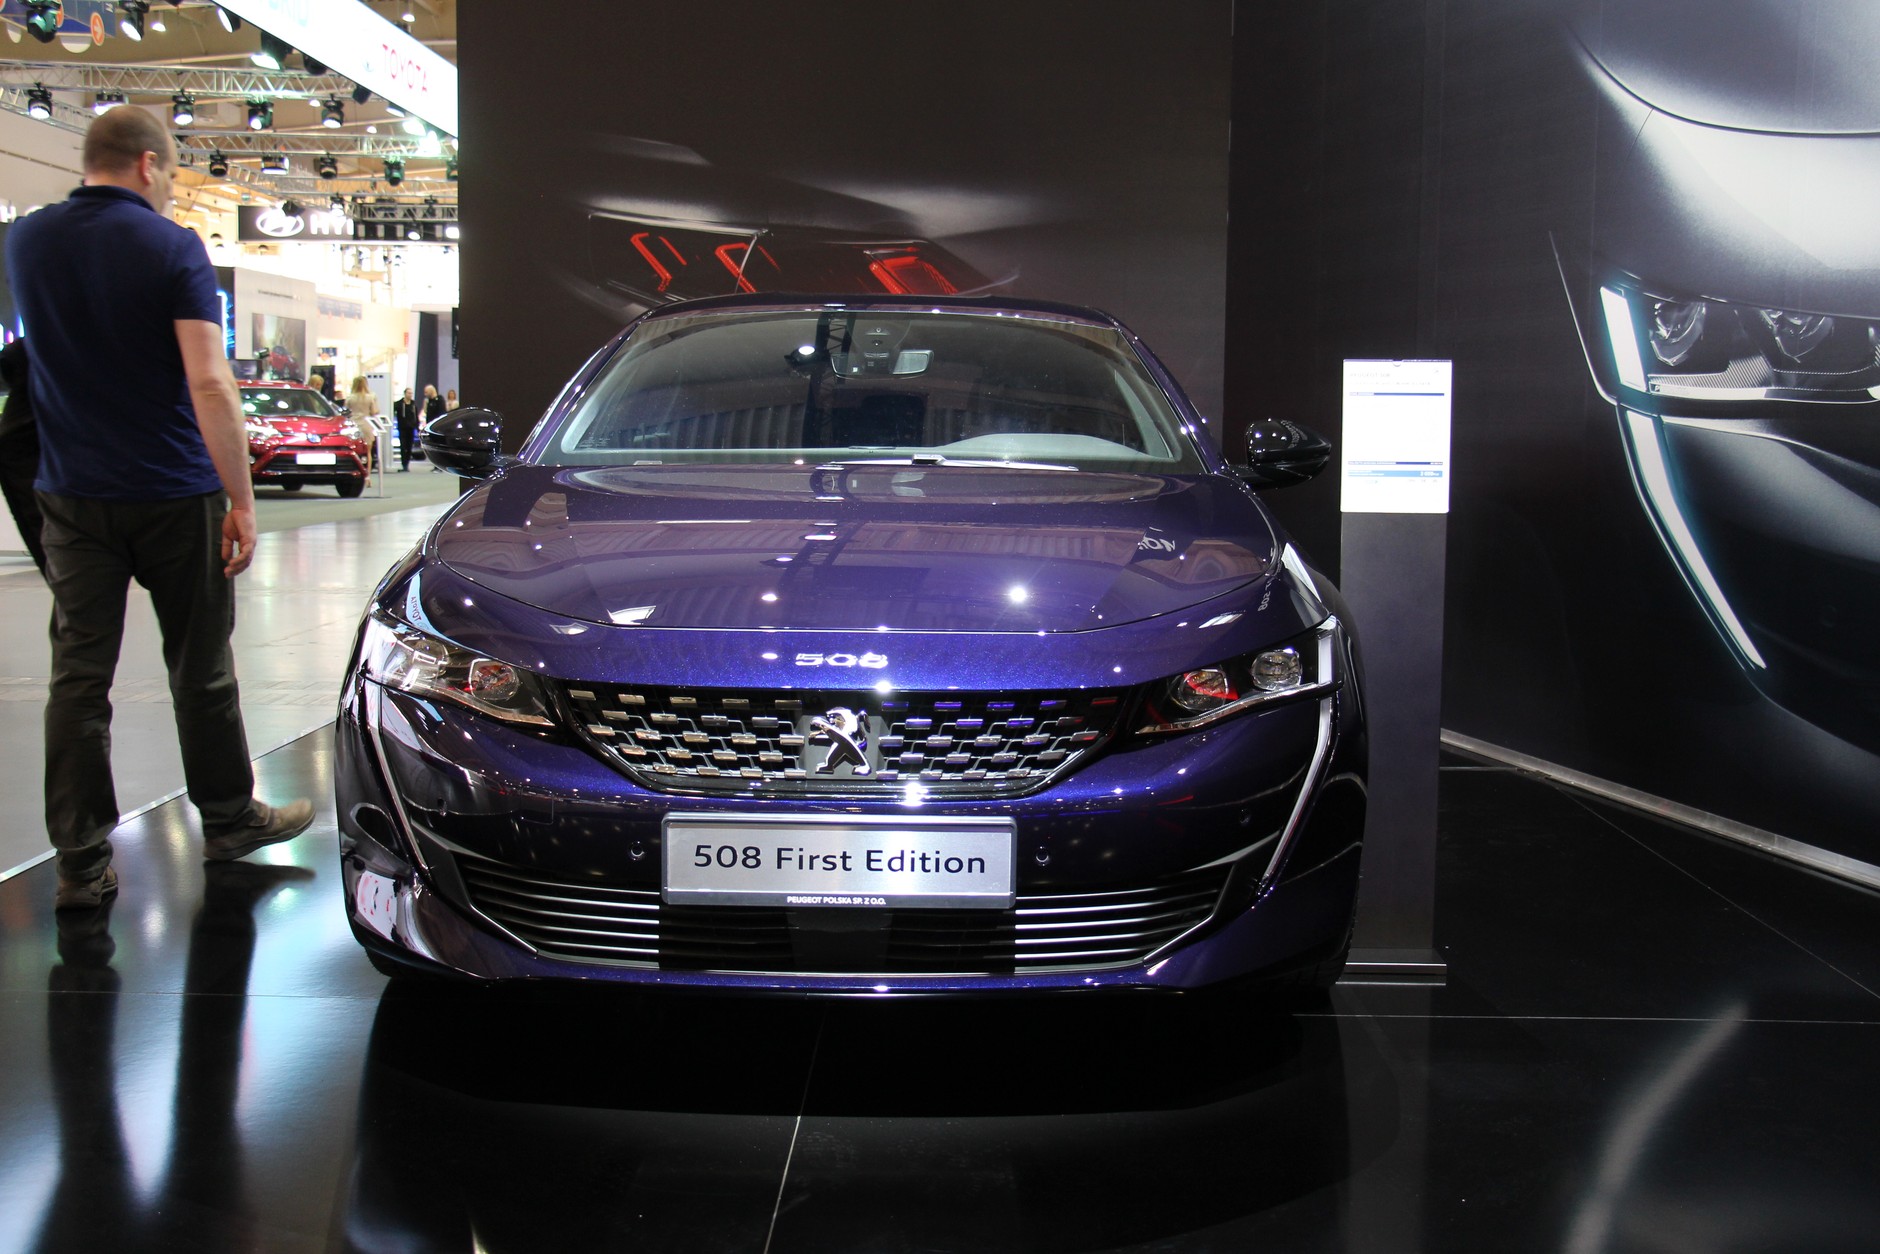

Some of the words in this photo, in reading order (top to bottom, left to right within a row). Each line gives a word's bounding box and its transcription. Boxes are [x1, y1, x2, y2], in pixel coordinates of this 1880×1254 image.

[382, 44, 428, 93] TOYOTA
[795, 651, 889, 669] 508
[694, 844, 762, 869] 508
[776, 847, 853, 872] First
[866, 849, 986, 874] Edition
[787, 895, 822, 904] PEUGEOT
[823, 896, 852, 905] POLSKA
[853, 896, 863, 905] SP.
